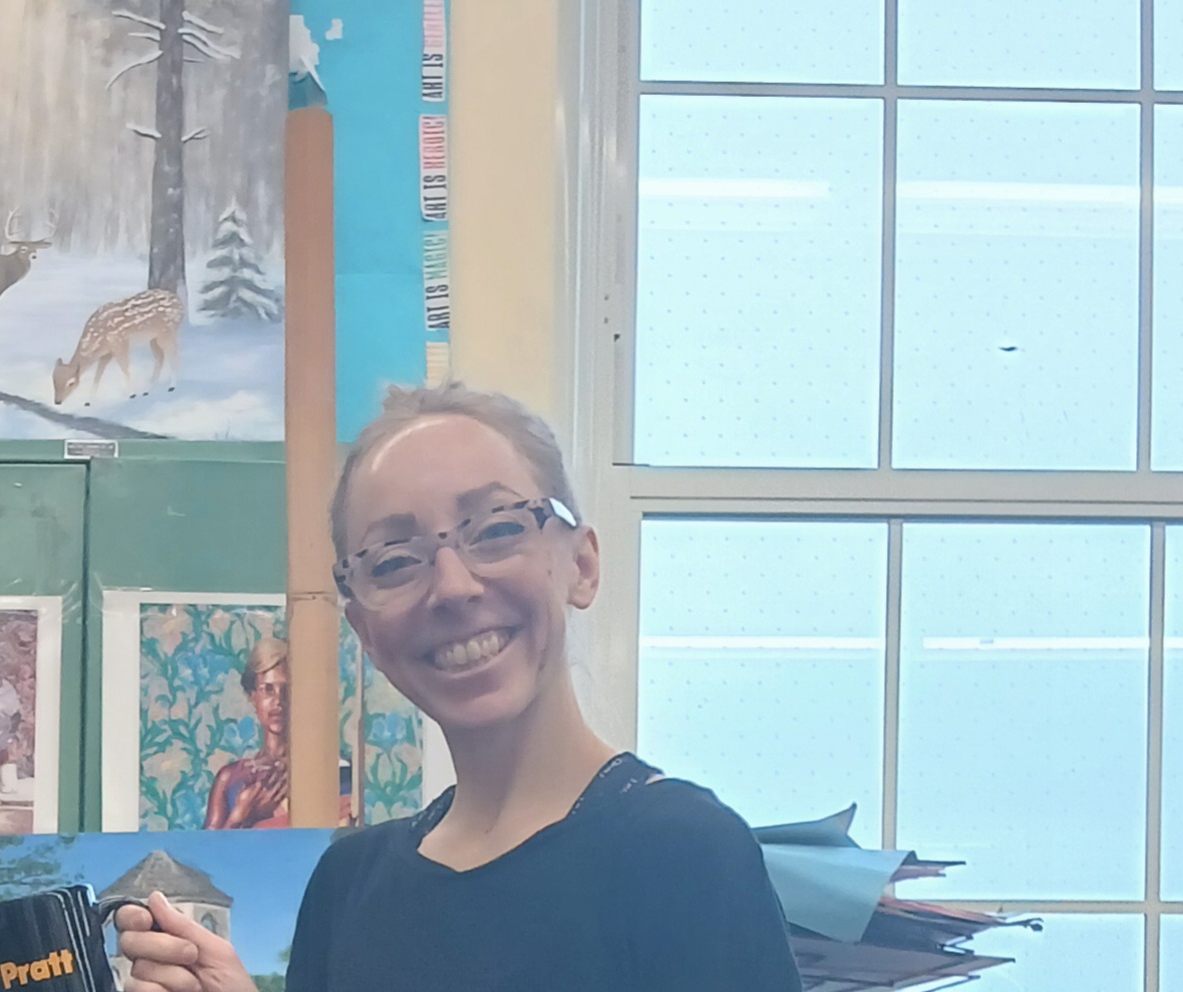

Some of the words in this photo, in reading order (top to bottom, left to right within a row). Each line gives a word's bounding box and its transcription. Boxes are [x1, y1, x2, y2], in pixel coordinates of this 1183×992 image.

[422, 53, 444, 68] IS
[422, 75, 443, 98] ART
[423, 174, 447, 189] IS
[423, 196, 447, 219] ART
[423, 233, 448, 280] MAGIC!
[425, 284, 450, 300] IS
[427, 305, 451, 329] ART
[0, 949, 76, 989] Pratt
